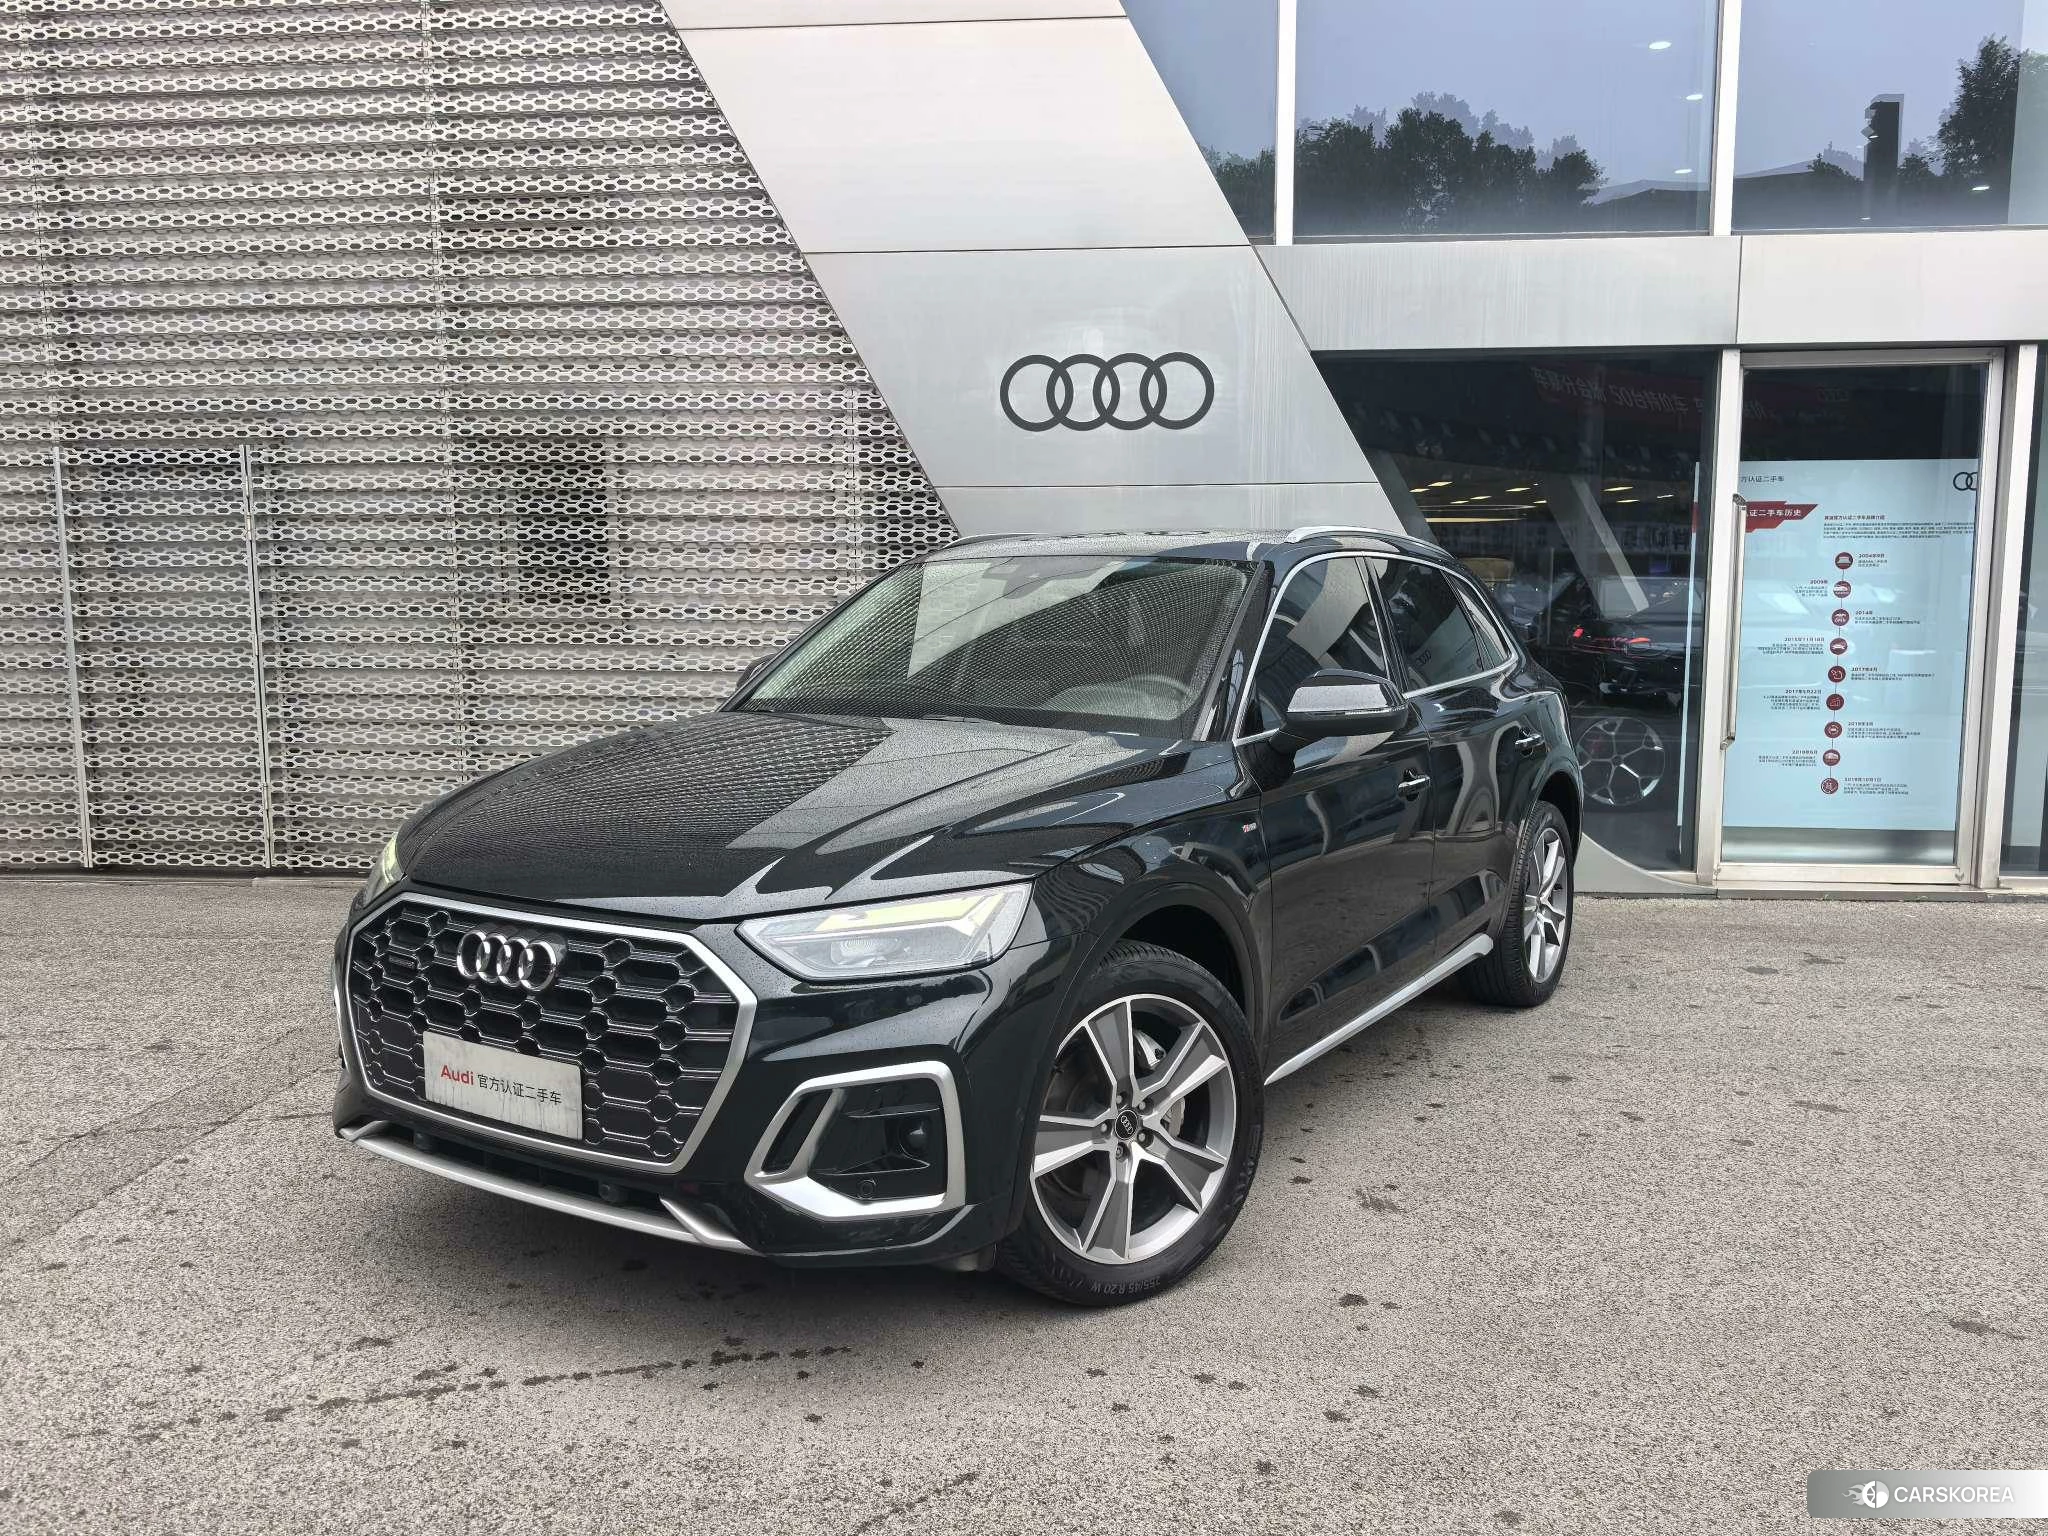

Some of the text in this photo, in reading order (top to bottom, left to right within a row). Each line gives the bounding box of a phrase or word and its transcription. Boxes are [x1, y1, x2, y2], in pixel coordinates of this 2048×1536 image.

[1746, 508, 1802, 518] 证二手车历史
[440, 1064, 563, 1105] Audi 官方认证二手车
